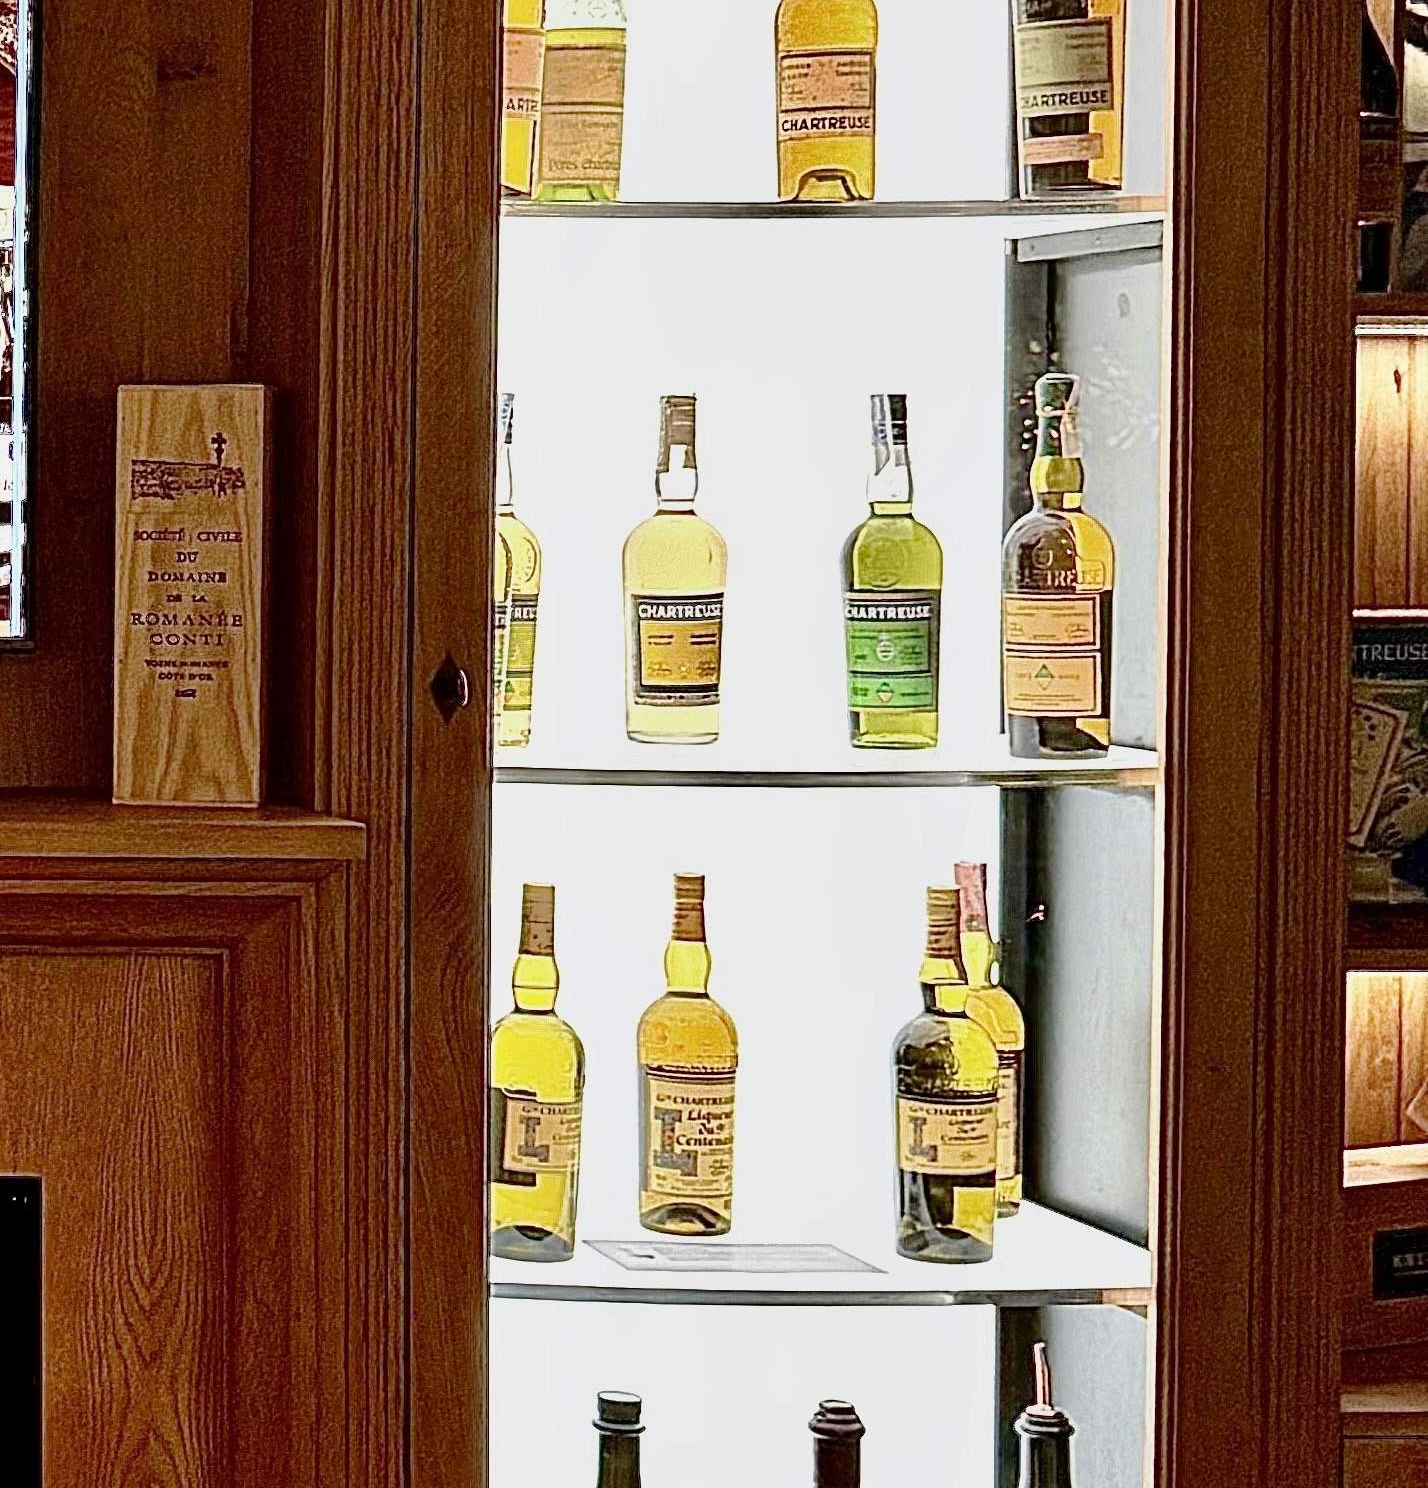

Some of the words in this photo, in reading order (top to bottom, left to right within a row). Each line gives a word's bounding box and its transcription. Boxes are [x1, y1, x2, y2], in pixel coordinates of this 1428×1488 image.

[781, 115, 871, 133] CHARTREUSE
[196, 530, 243, 543] CIVILE
[175, 551, 199, 564] DU
[147, 570, 228, 584] DOMAINE
[166, 593, 183, 603] DE
[191, 593, 208, 603] LA
[130, 609, 243, 627] ROMANÉE
[638, 603, 724, 619] CHARTREUSE
[845, 605, 932, 619] CHARTREUSE
[149, 632, 225, 647] CONTI
[687, 1108, 734, 1125] Liqueu
